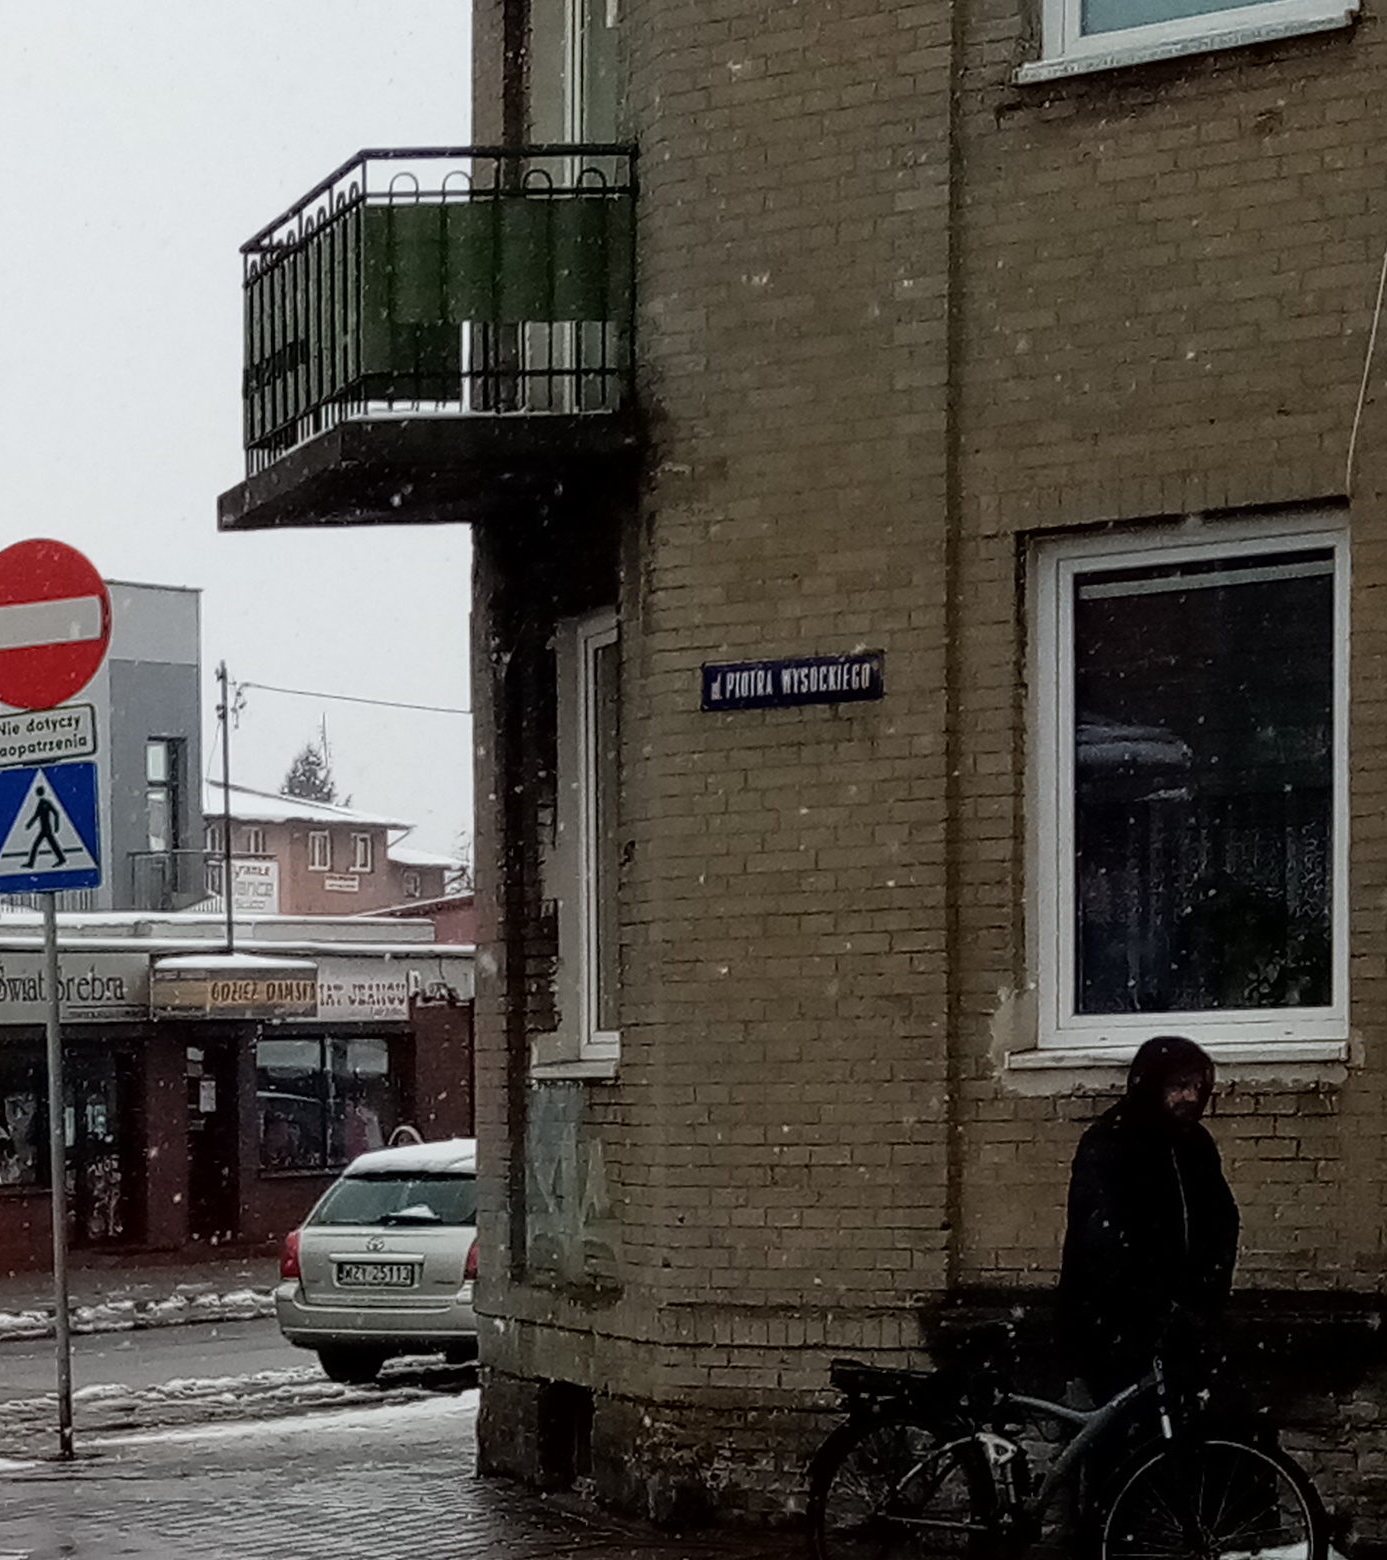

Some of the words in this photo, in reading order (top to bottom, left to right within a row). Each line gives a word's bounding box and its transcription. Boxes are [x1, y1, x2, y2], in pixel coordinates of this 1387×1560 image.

[726, 669, 774, 699] PIOTRA
[781, 662, 872, 695] WYSOCKIEGO
[26, 715, 80, 733] dotyczy
